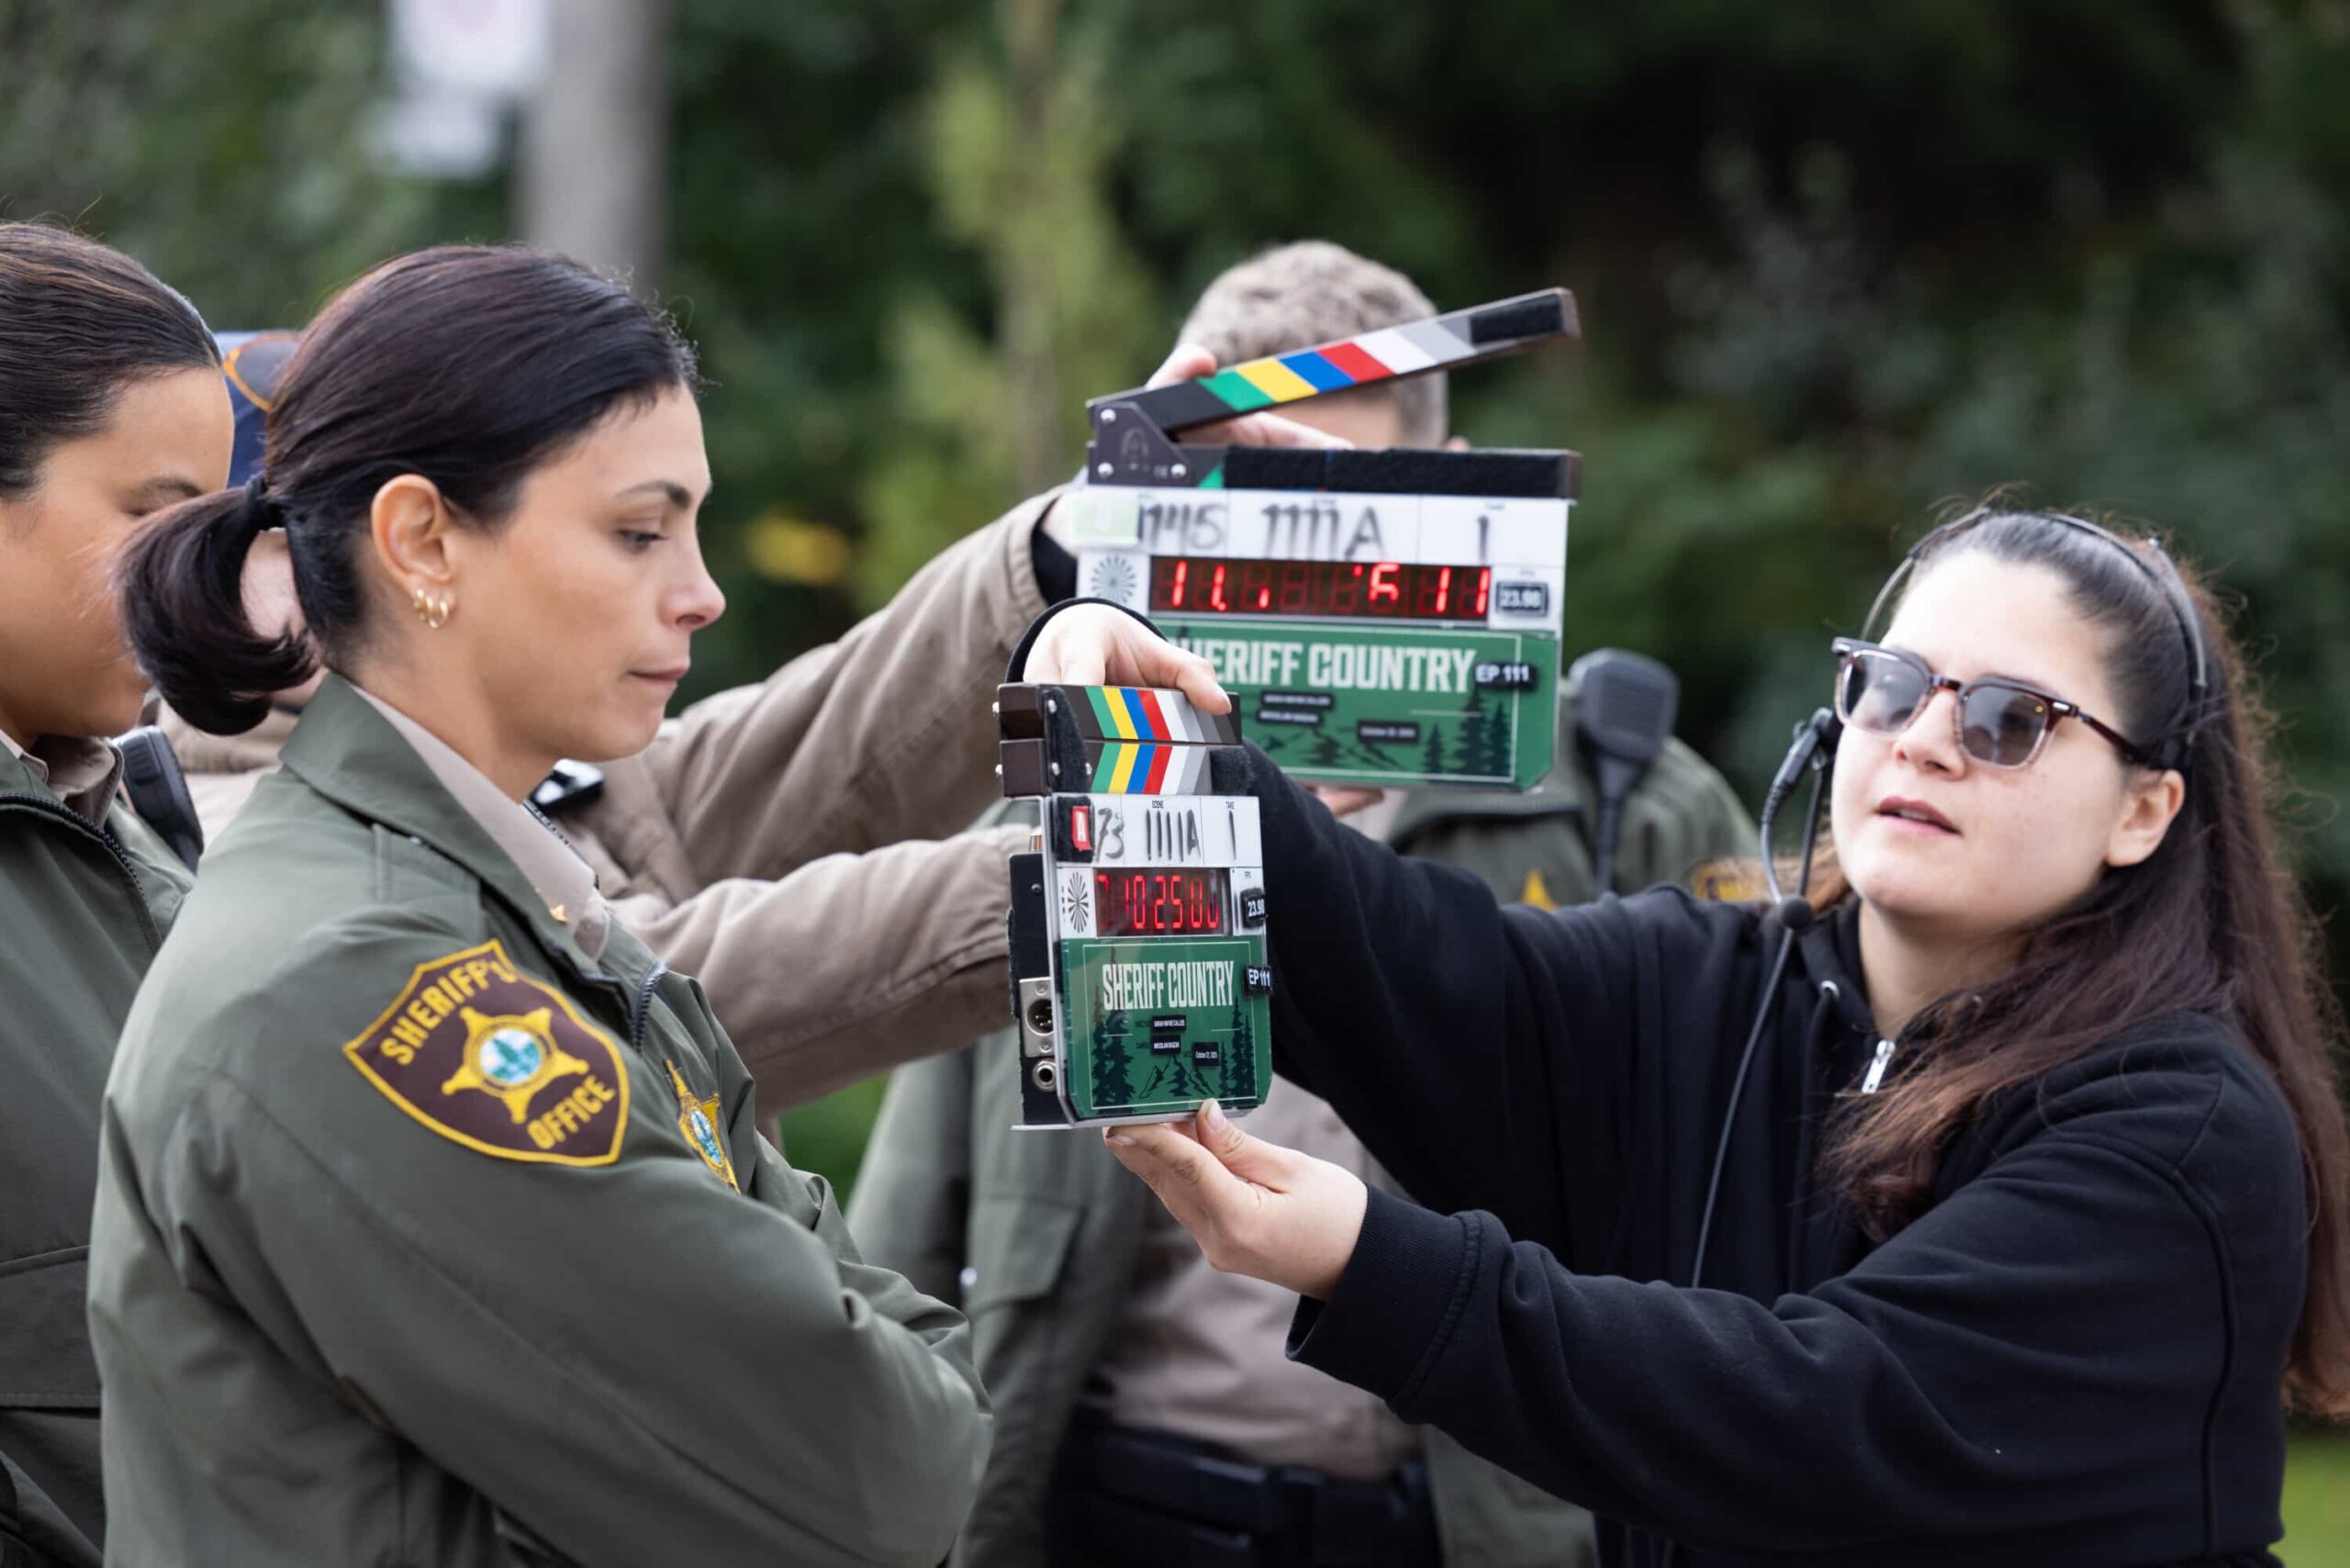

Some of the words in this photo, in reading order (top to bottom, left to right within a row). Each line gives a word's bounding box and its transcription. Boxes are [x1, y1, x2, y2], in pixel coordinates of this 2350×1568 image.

[1477, 515, 1490, 565] 1
[1171, 637, 1303, 688] ERIFF
[1308, 644, 1477, 694] COUNTRY
[1474, 665, 1501, 683] EP
[1503, 663, 1531, 683] 111
[1102, 963, 1165, 1011] SHERIFF
[1167, 960, 1235, 1009] COUNTRY
[1248, 969, 1259, 985] EP
[1259, 970, 1271, 987] 111
[526, 1074, 616, 1149] OFFICE
